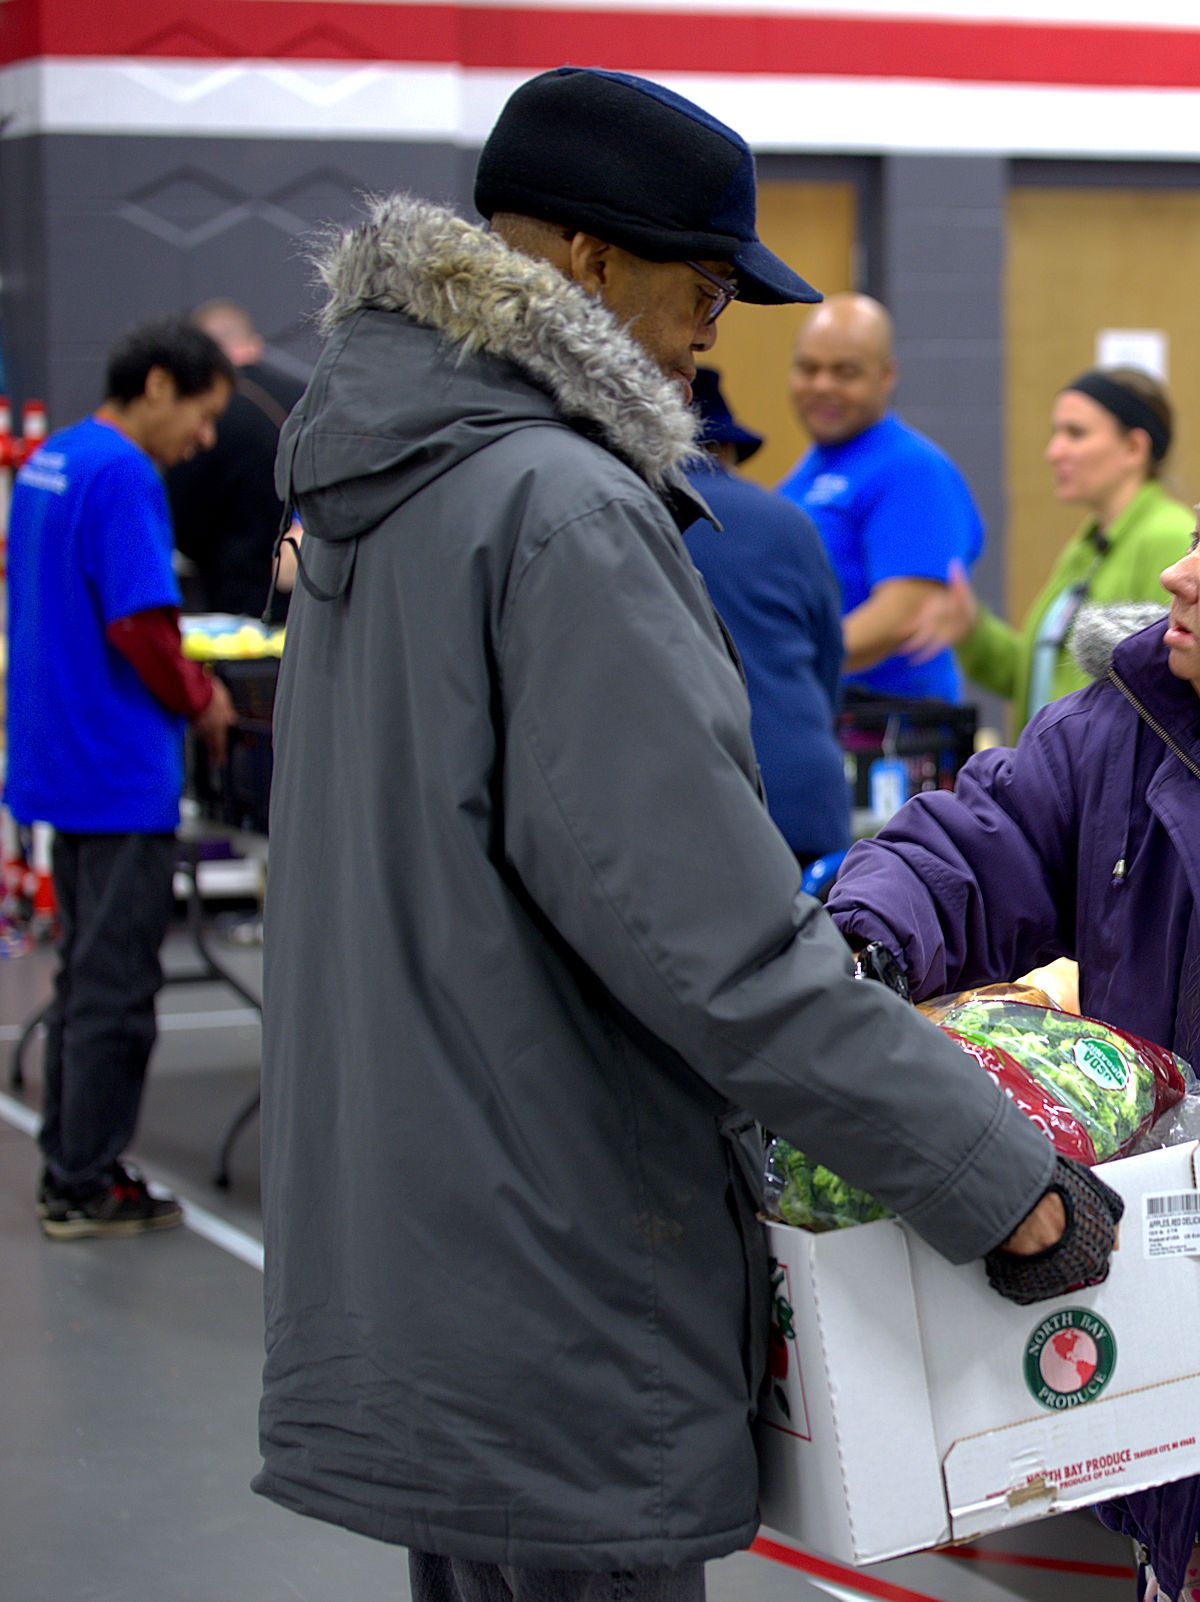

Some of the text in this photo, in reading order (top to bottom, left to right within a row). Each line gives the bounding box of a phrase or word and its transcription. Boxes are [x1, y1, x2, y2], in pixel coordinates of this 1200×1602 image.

[1029, 1312, 1108, 1356] NORTH BAY
[1038, 1371, 1106, 1409] PRODUCE
[1064, 1462, 1084, 1478] BAY
[1086, 1449, 1131, 1472] PRODUCE
[1060, 1475, 1092, 1489] PRODUCE
[1093, 1472, 1102, 1481] OF
